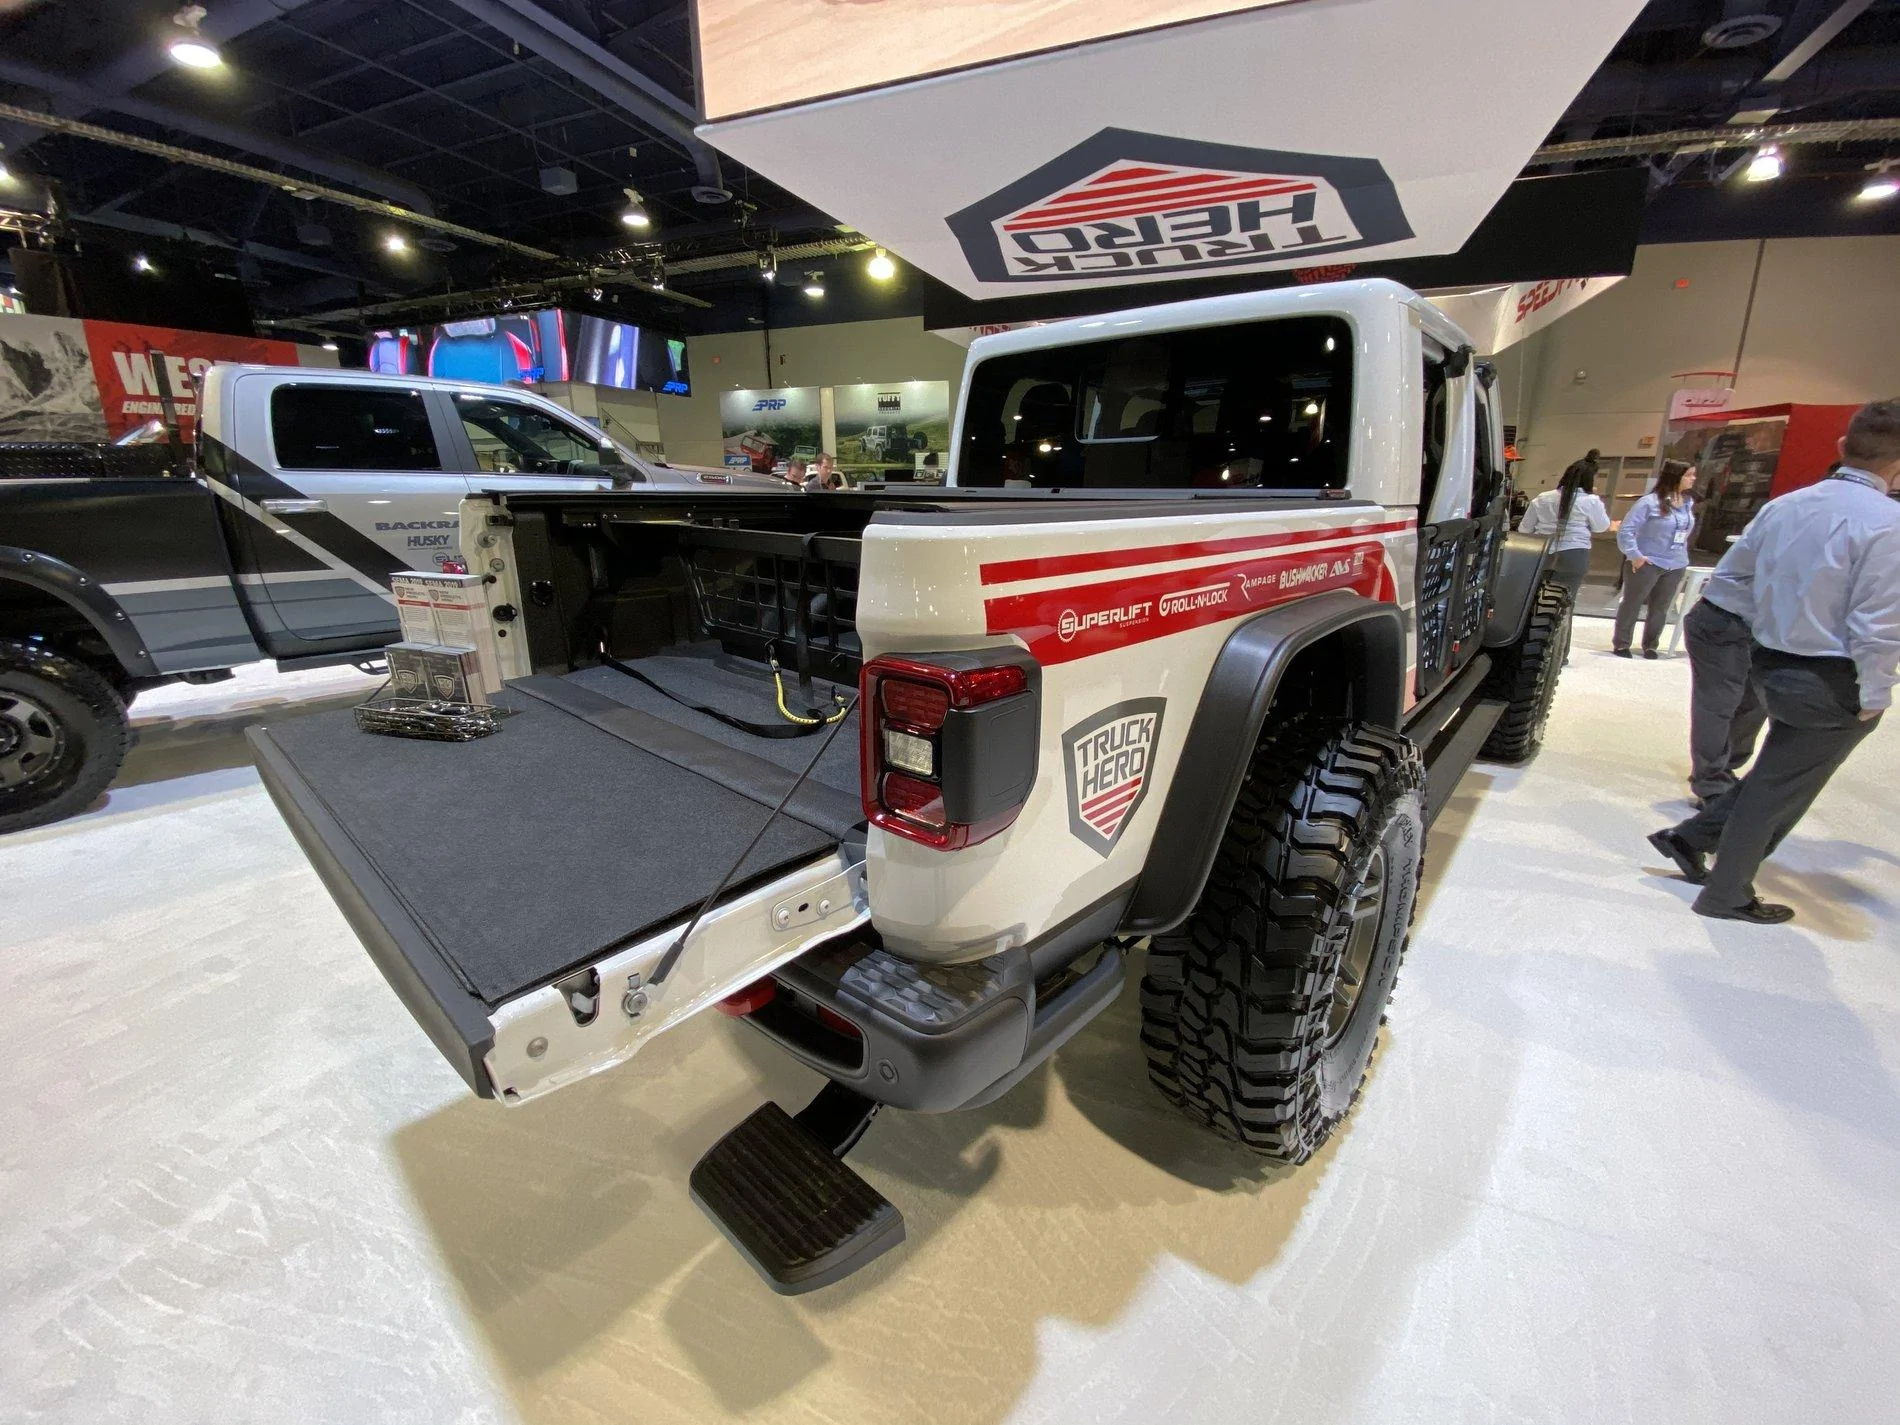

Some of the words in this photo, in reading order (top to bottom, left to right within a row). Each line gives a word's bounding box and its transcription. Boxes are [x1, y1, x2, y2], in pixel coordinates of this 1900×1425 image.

[1011, 191, 1317, 254] HERO
[1012, 224, 1348, 273] TRUCK
[753, 399, 786, 411] PRP
[407, 534, 450, 547] HUSKY
[1058, 602, 1152, 637] SUPERLIFT
[1236, 573, 1276, 601] RAMPAGE
[1279, 562, 1328, 590] BUSHWACKER
[1077, 717, 1154, 768] TRUCK
[1081, 746, 1146, 800] HERO
